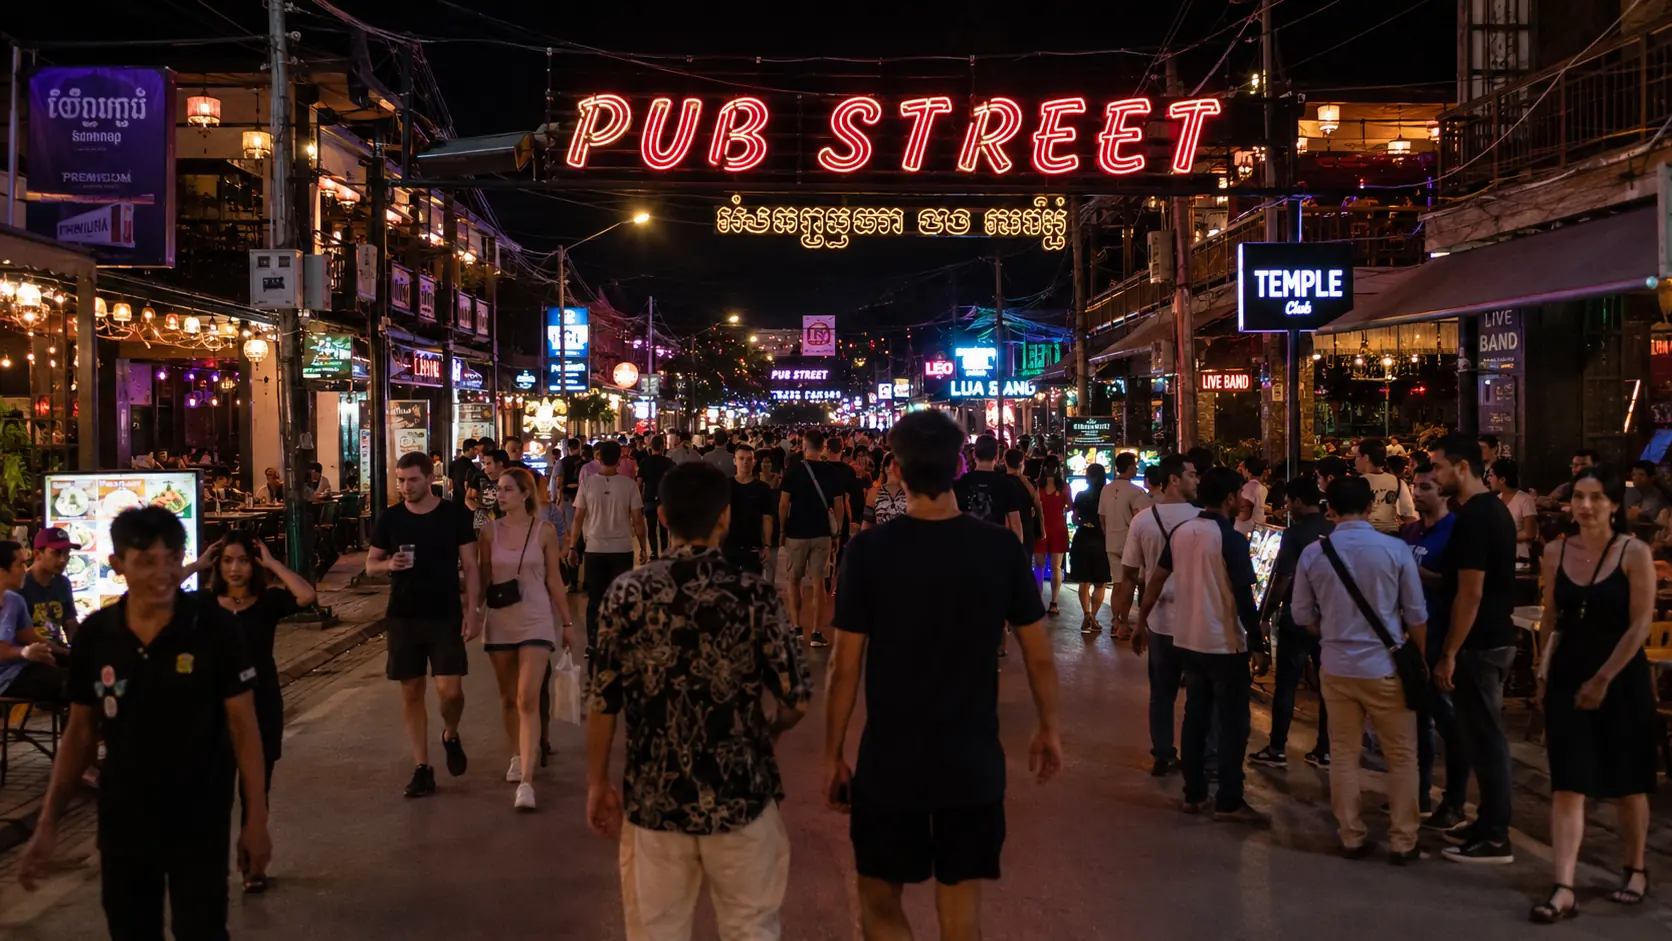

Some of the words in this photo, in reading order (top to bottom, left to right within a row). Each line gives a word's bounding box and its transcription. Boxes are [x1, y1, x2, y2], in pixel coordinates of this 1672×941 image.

[566, 94, 769, 172] PUB
[817, 96, 1222, 174] STREET
[1253, 269, 1343, 298] TEMPLE
[1285, 300, 1312, 315] Club
[1484, 309, 1513, 328] LIVE
[1479, 331, 1518, 353] BAND
[771, 369, 791, 380] PUB
[793, 369, 829, 380] STREET
[925, 361, 954, 376] LEO
[950, 380, 985, 397] LUA
[1202, 374, 1222, 389] LIVE
[1224, 374, 1249, 389] BAND
